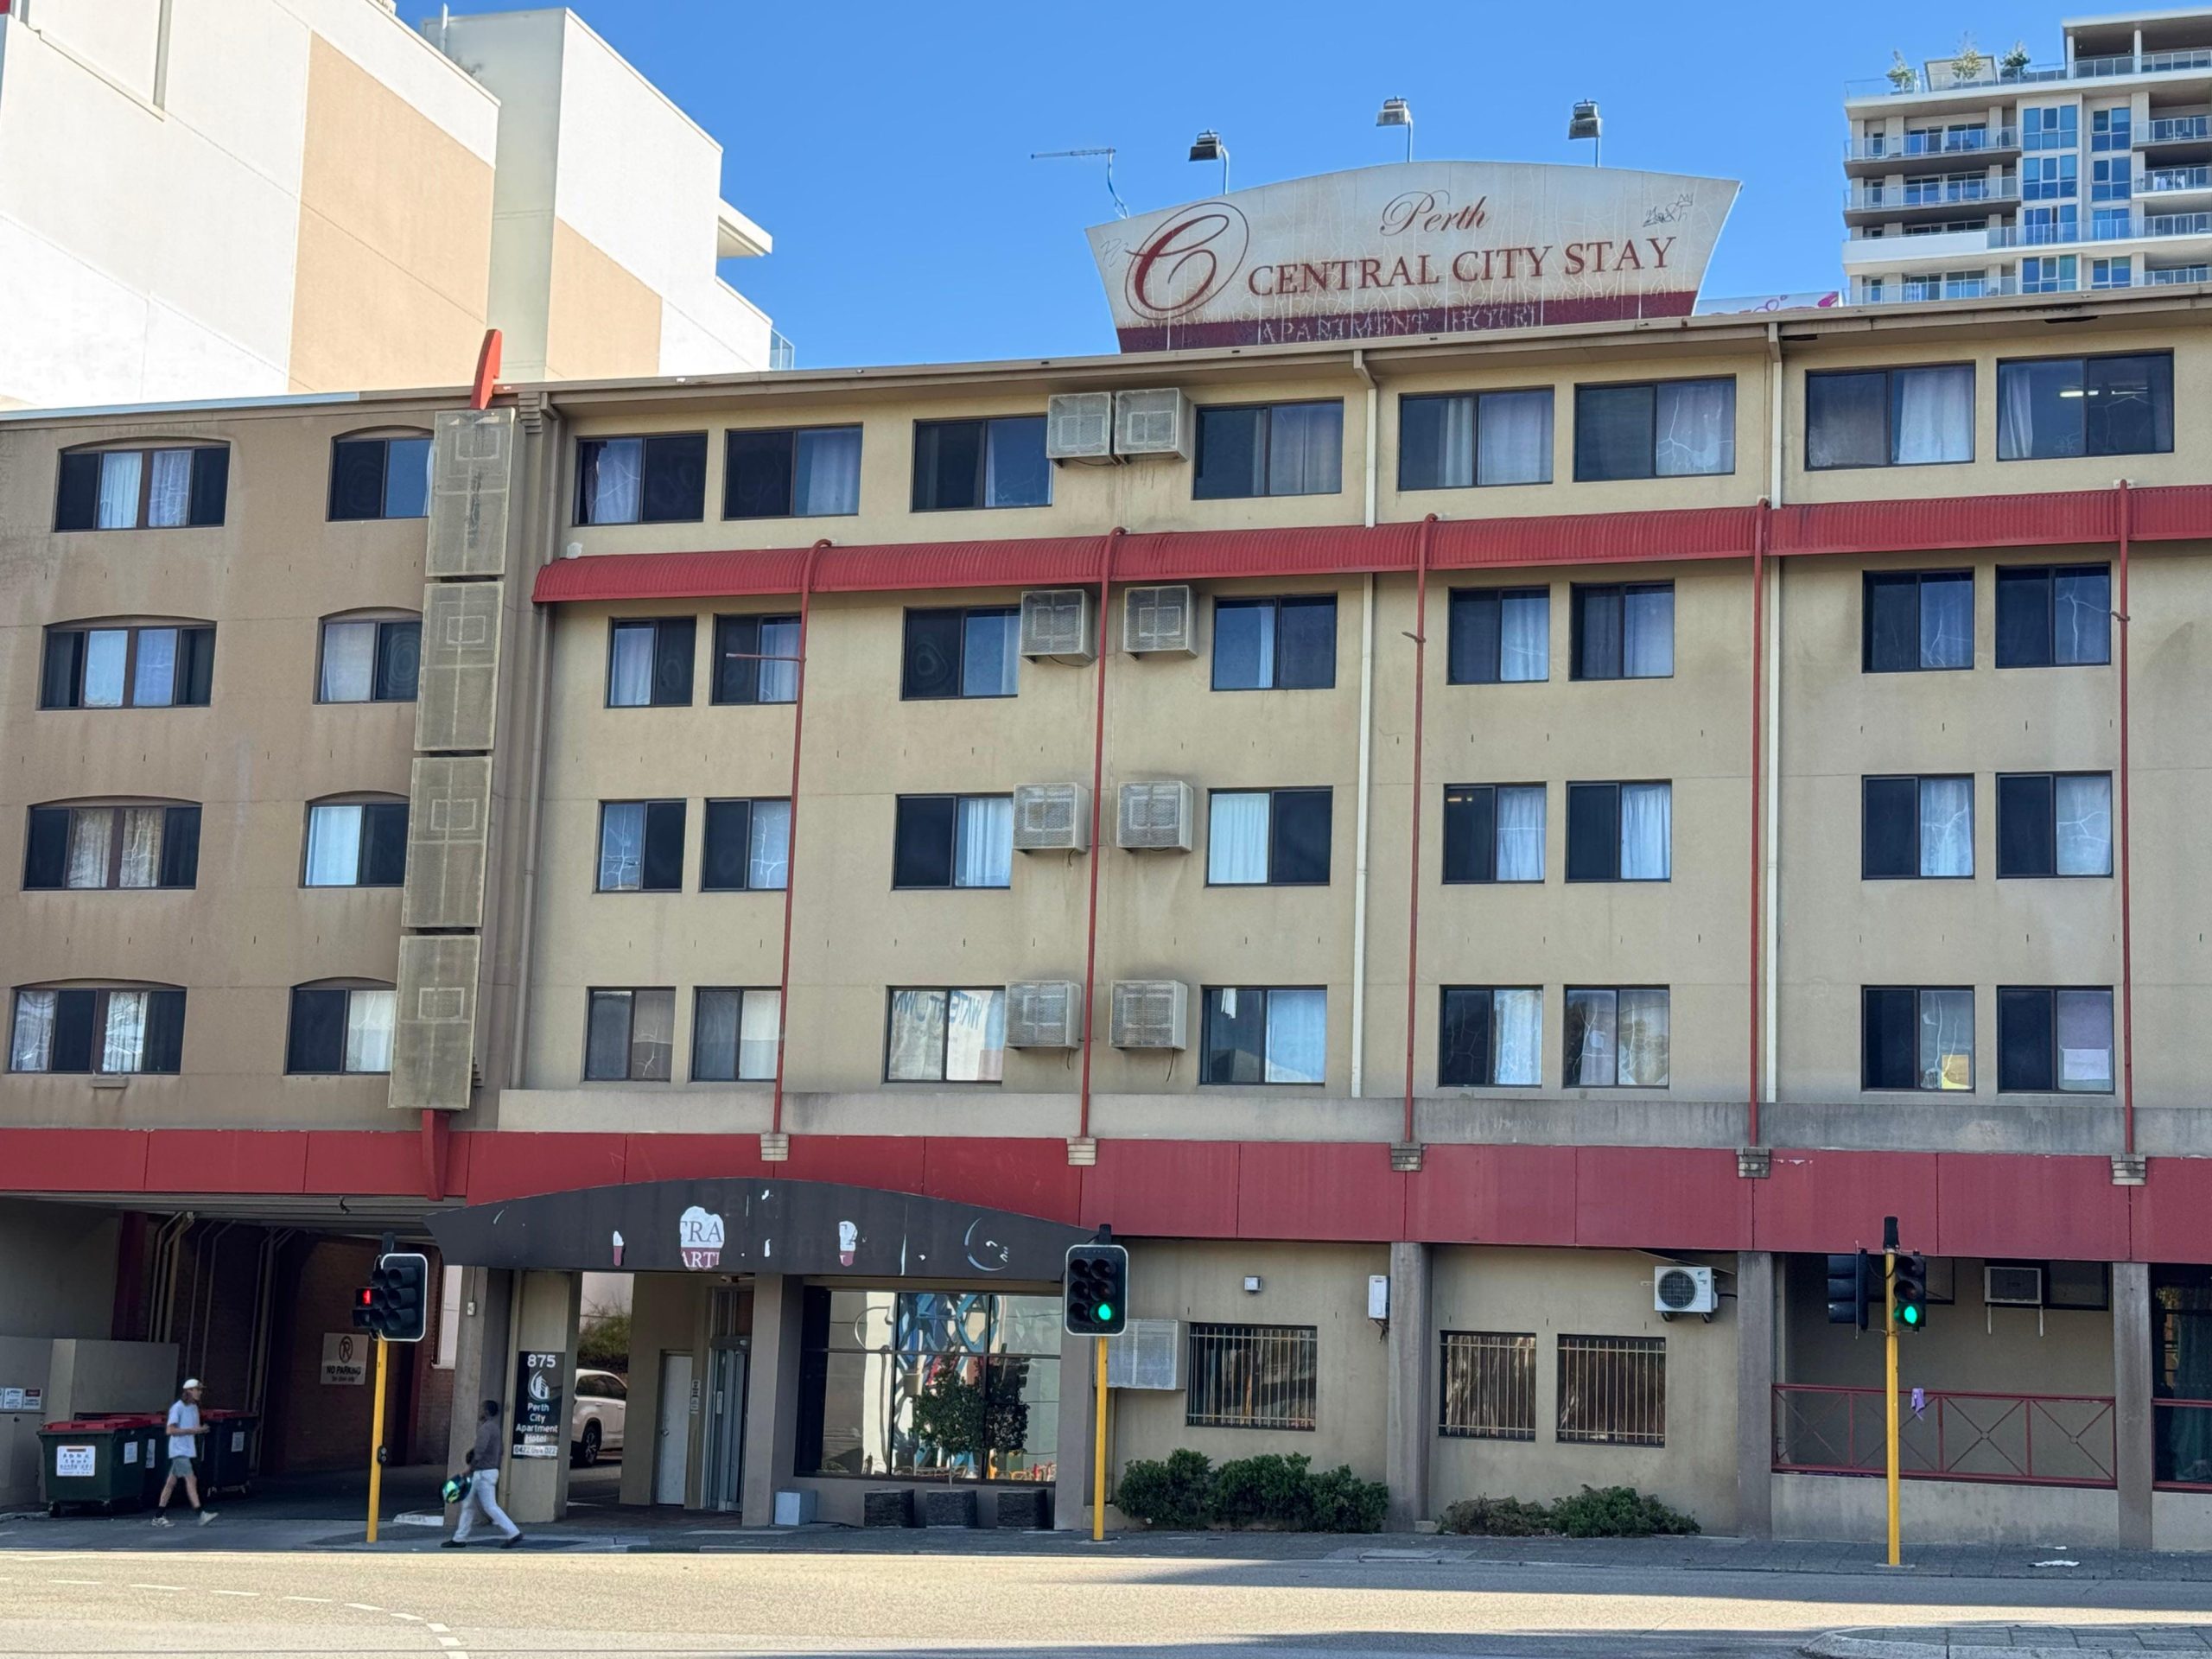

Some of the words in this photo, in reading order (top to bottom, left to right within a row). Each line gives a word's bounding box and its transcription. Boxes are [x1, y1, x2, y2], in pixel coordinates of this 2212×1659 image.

[1380, 189, 1490, 236] Perth
[1248, 254, 1440, 296] CENTRAL
[1452, 245, 1554, 283] CITY
[1565, 237, 1676, 275] STAY
[527, 1354, 556, 1368] 875
[326, 1365, 335, 1375] NO
[336, 1365, 361, 1376] PARKING
[527, 1402, 550, 1412] Perth
[529, 1414, 546, 1424] City
[516, 1423, 558, 1433] Apartment
[525, 1434, 547, 1443] Hotel
